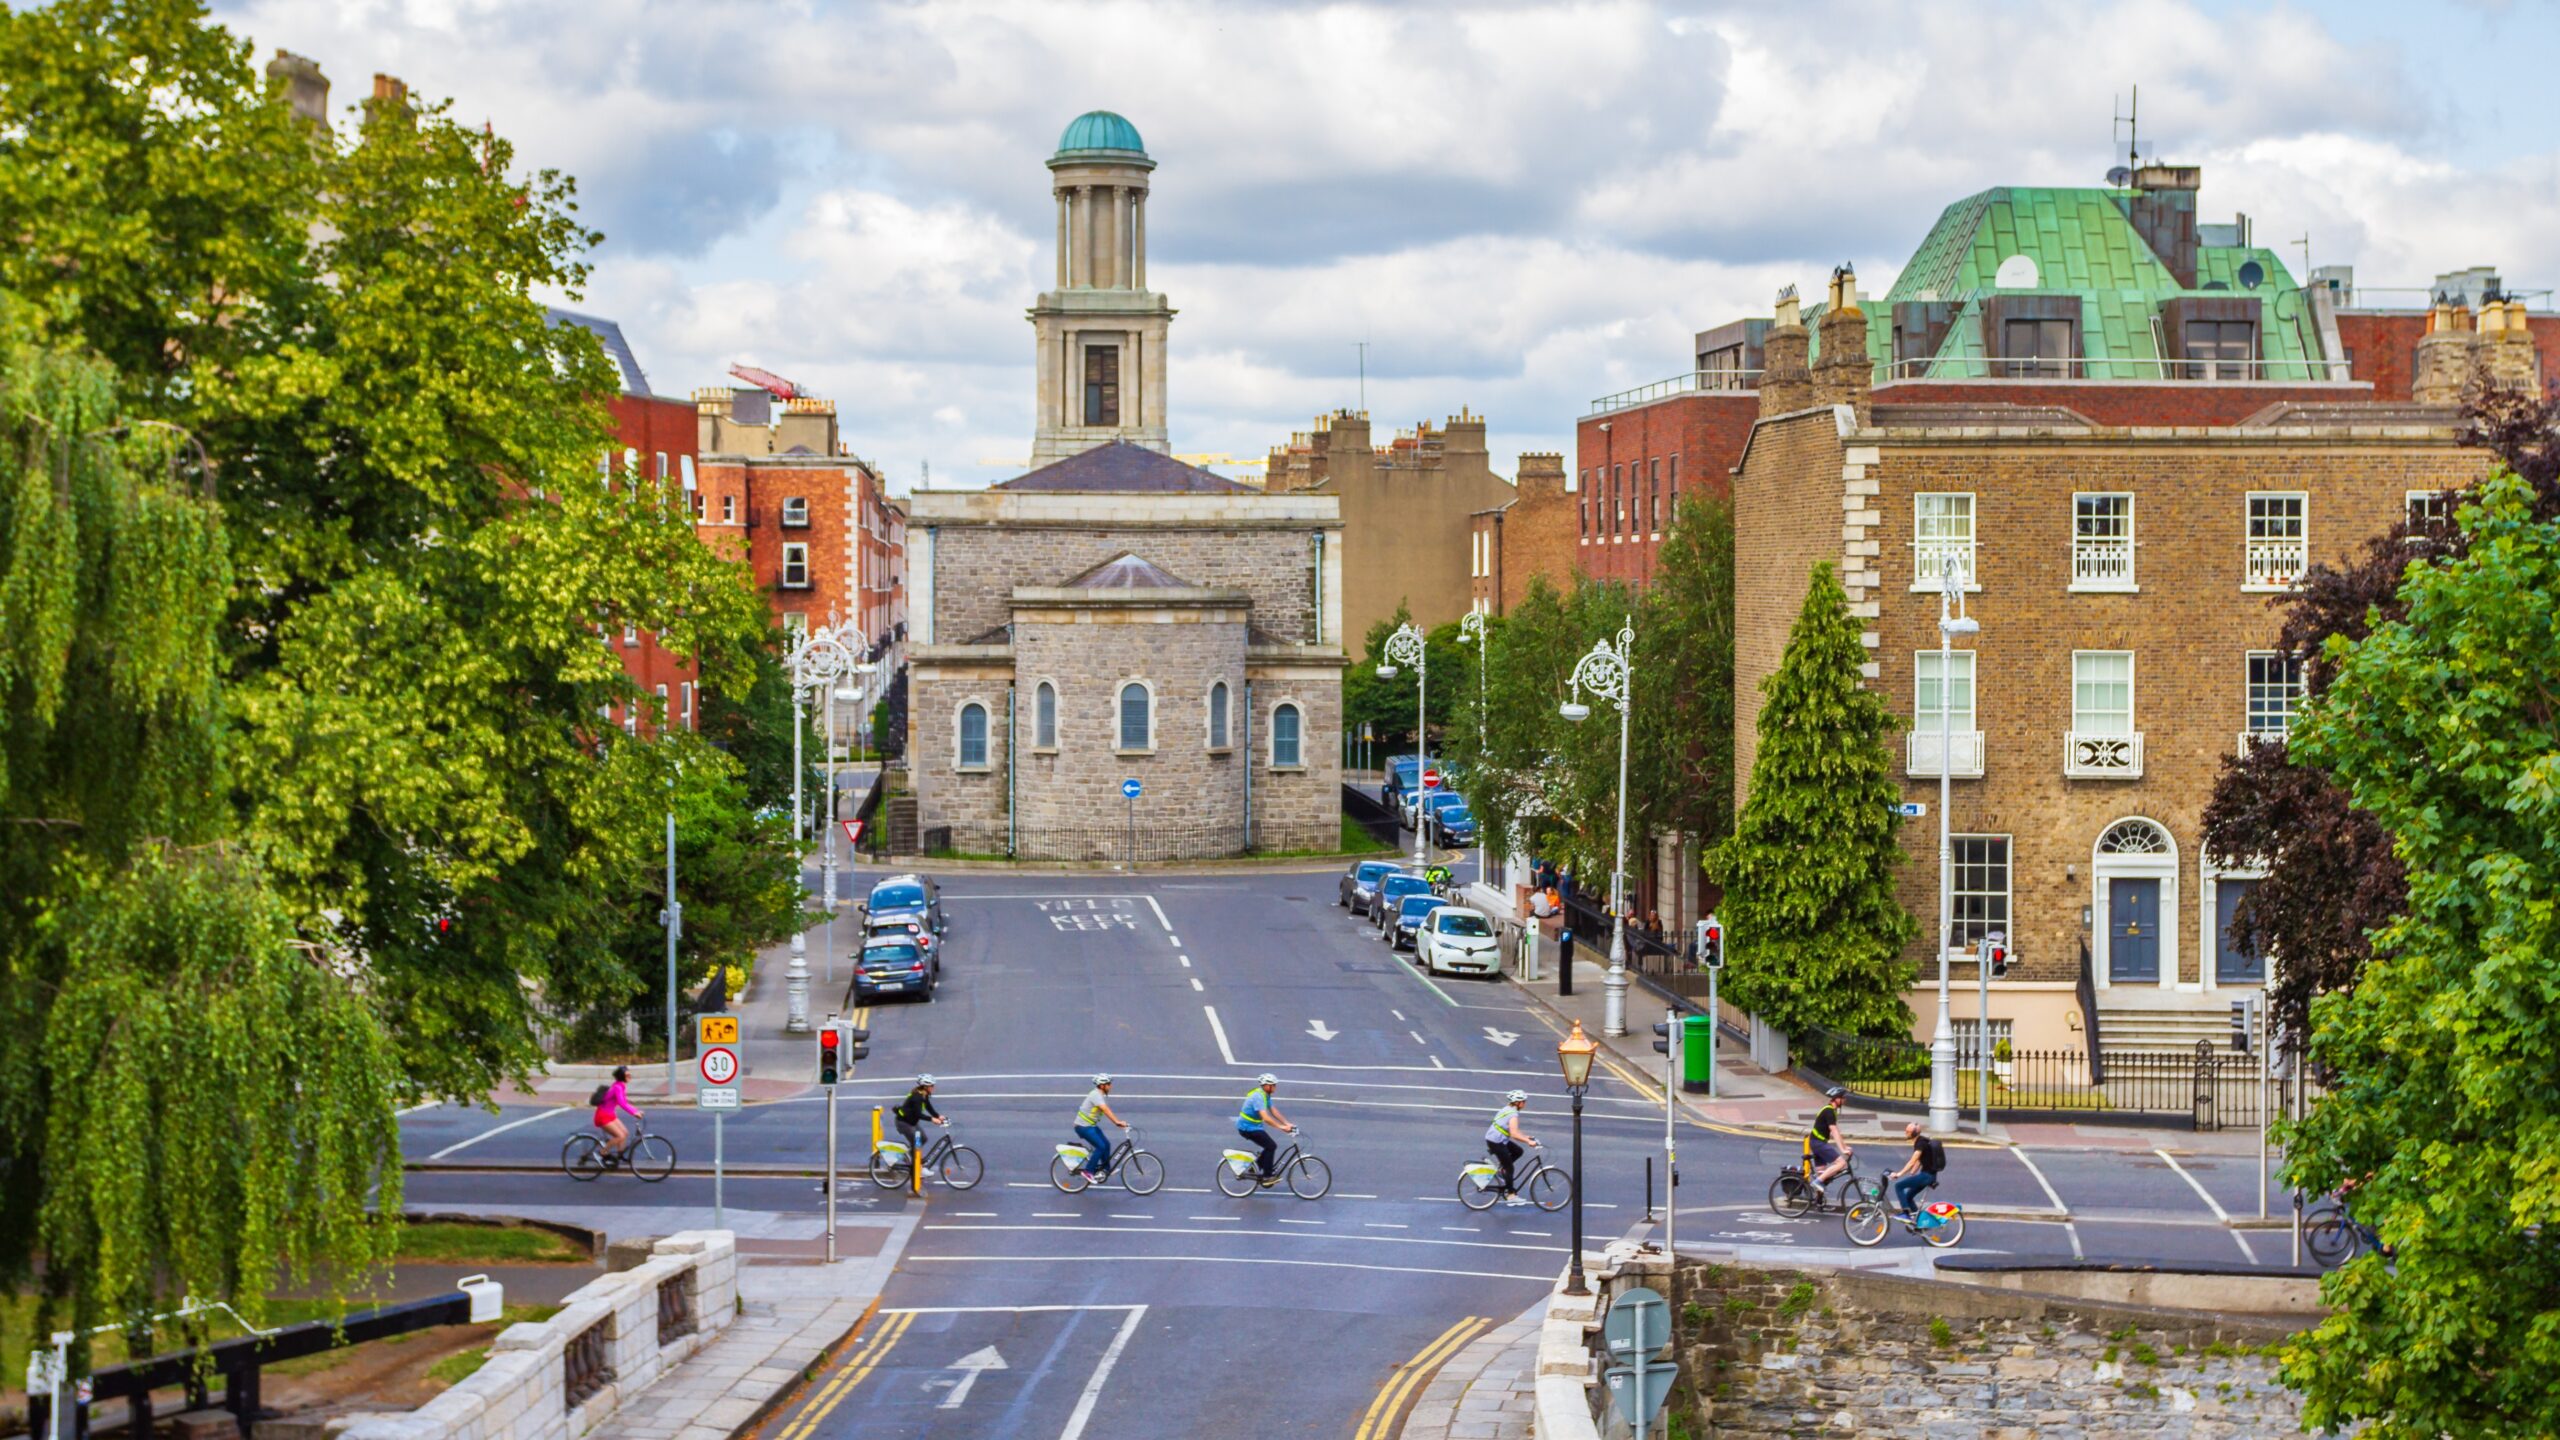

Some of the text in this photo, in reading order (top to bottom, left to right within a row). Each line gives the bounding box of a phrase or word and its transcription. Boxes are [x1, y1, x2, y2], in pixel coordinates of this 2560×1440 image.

[1049, 914, 1133, 924] KEEP
[1054, 922, 1139, 931] LEFT
[711, 1056, 728, 1071] 30
